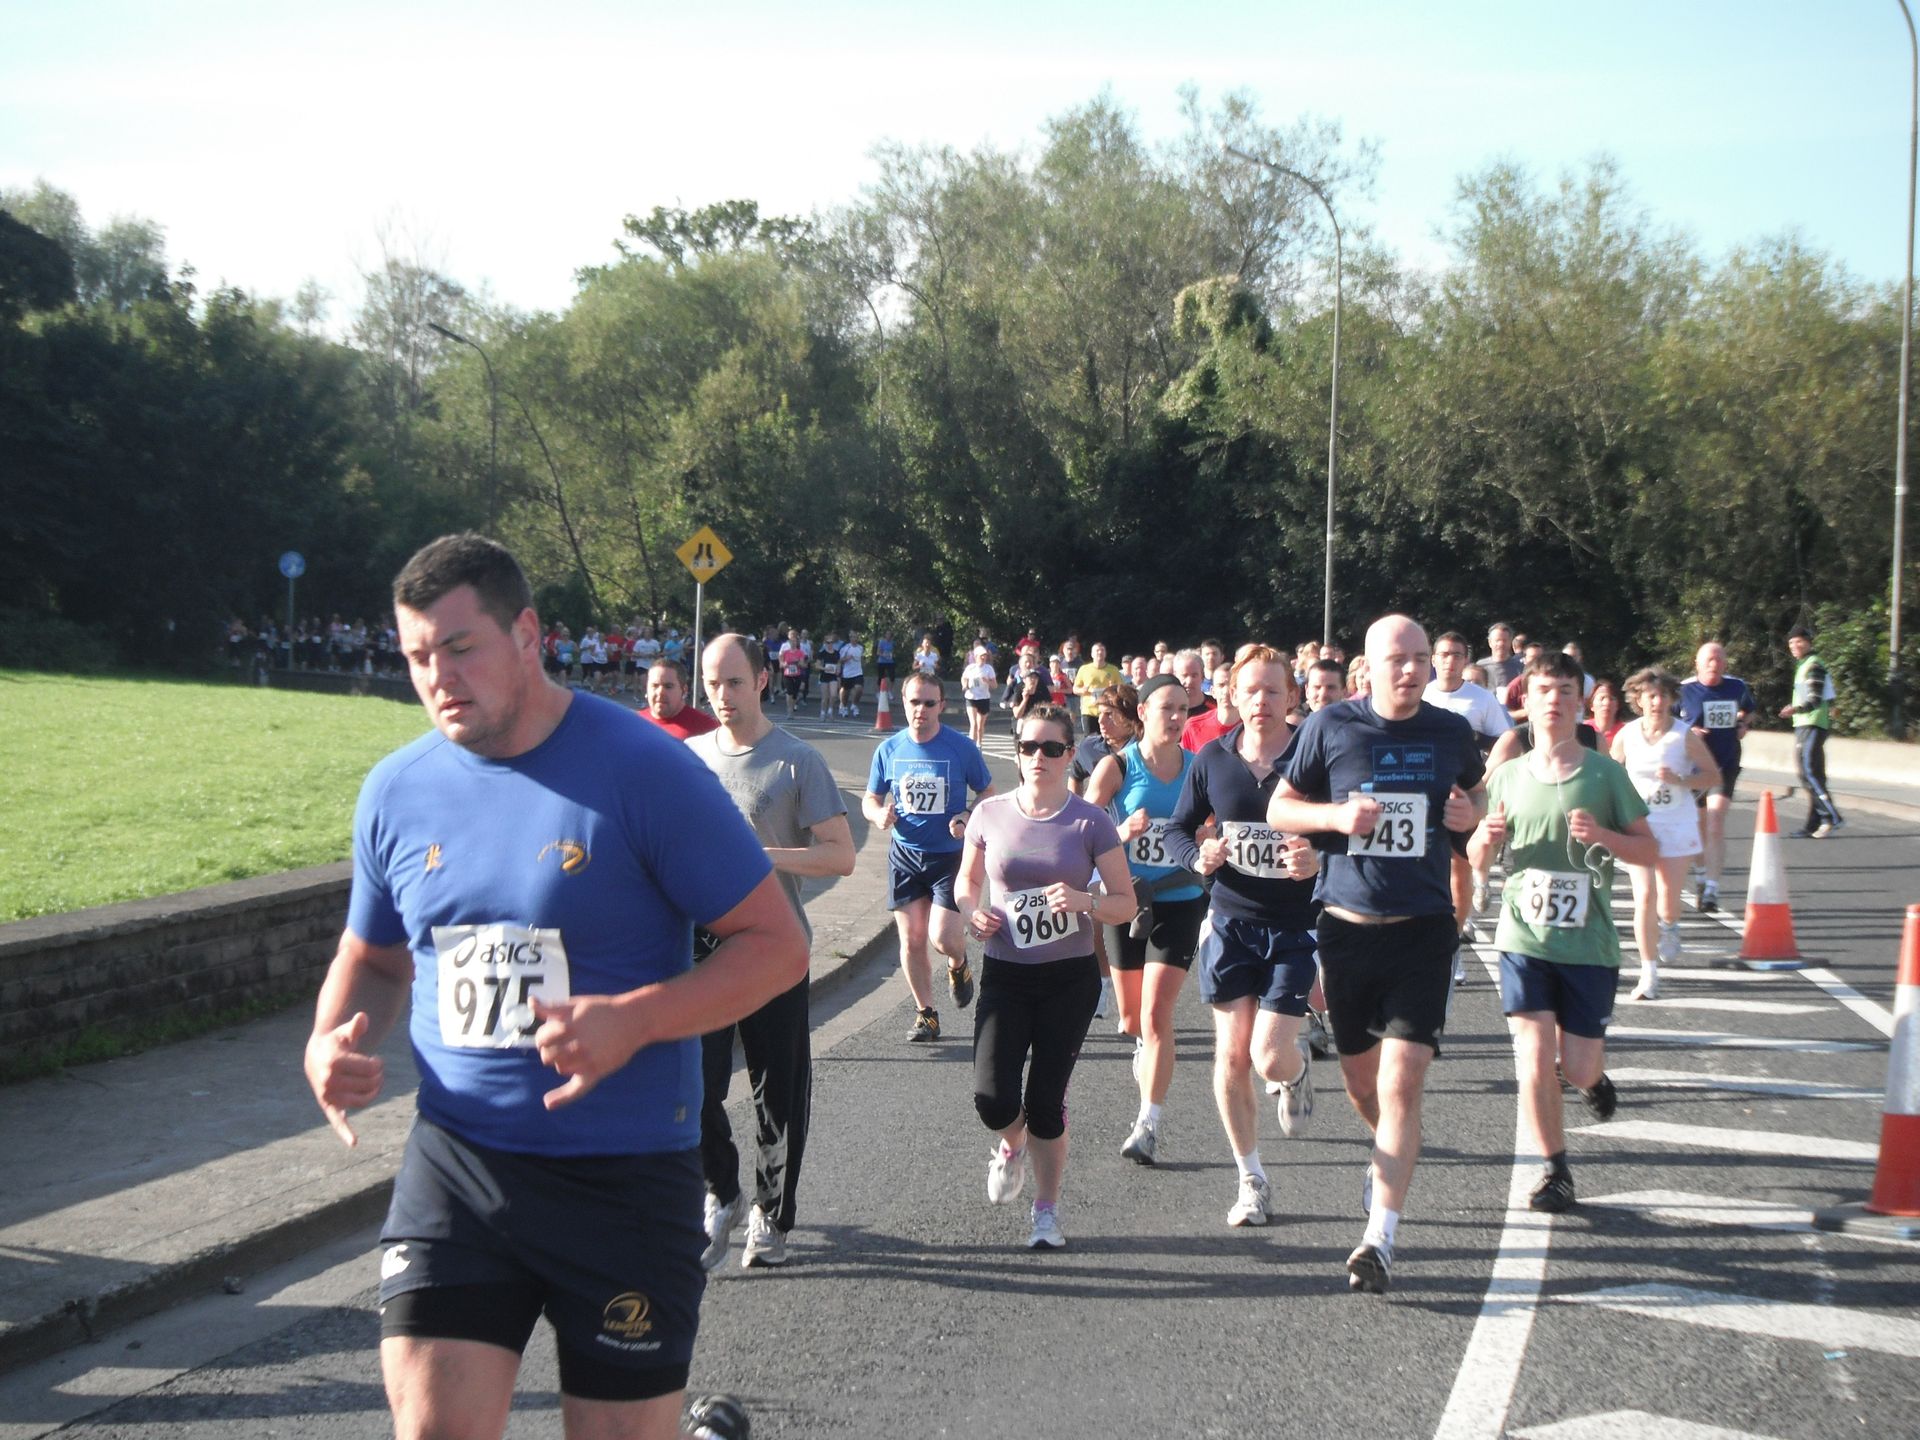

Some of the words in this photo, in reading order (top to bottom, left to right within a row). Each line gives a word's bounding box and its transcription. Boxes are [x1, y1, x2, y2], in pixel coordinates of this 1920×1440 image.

[1709, 711, 1732, 726] 982
[1373, 773, 1414, 782] RaceSeries
[906, 792, 938, 812] 927
[1647, 790, 1672, 805] 35
[1252, 829, 1284, 841] asics
[1136, 836, 1175, 863] 85
[1234, 841, 1289, 869] 1042
[1531, 893, 1578, 923] 952
[1016, 910, 1069, 945] 960
[480, 941, 544, 965] asics
[454, 974, 545, 1037] 975
